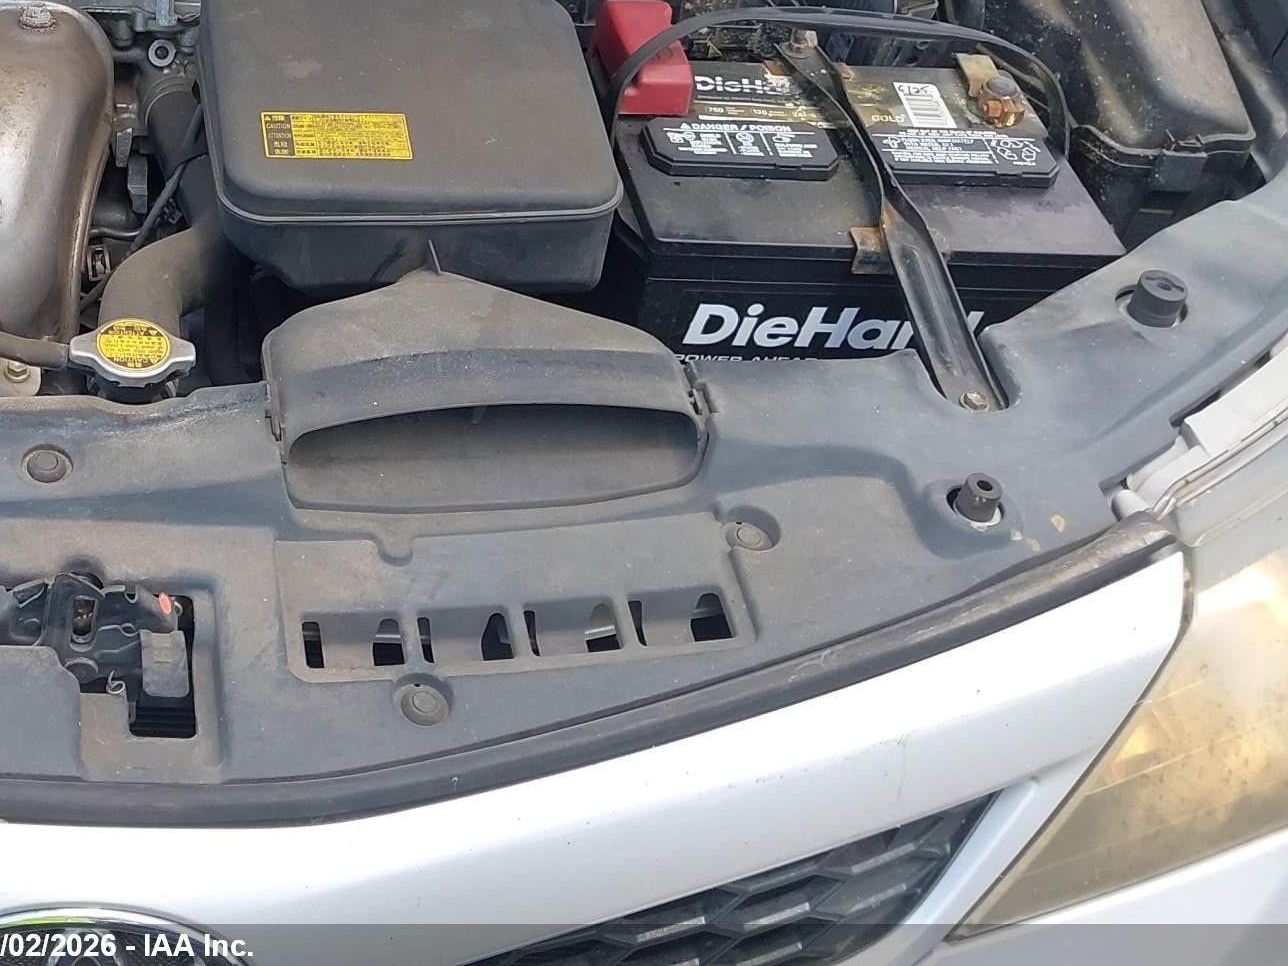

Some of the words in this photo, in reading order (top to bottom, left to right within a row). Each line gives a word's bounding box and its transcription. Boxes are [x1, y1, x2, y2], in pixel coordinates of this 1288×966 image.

[871, 112, 905, 123] GOLD
[691, 123, 739, 131] DANGER
[748, 124, 792, 132] POISON
